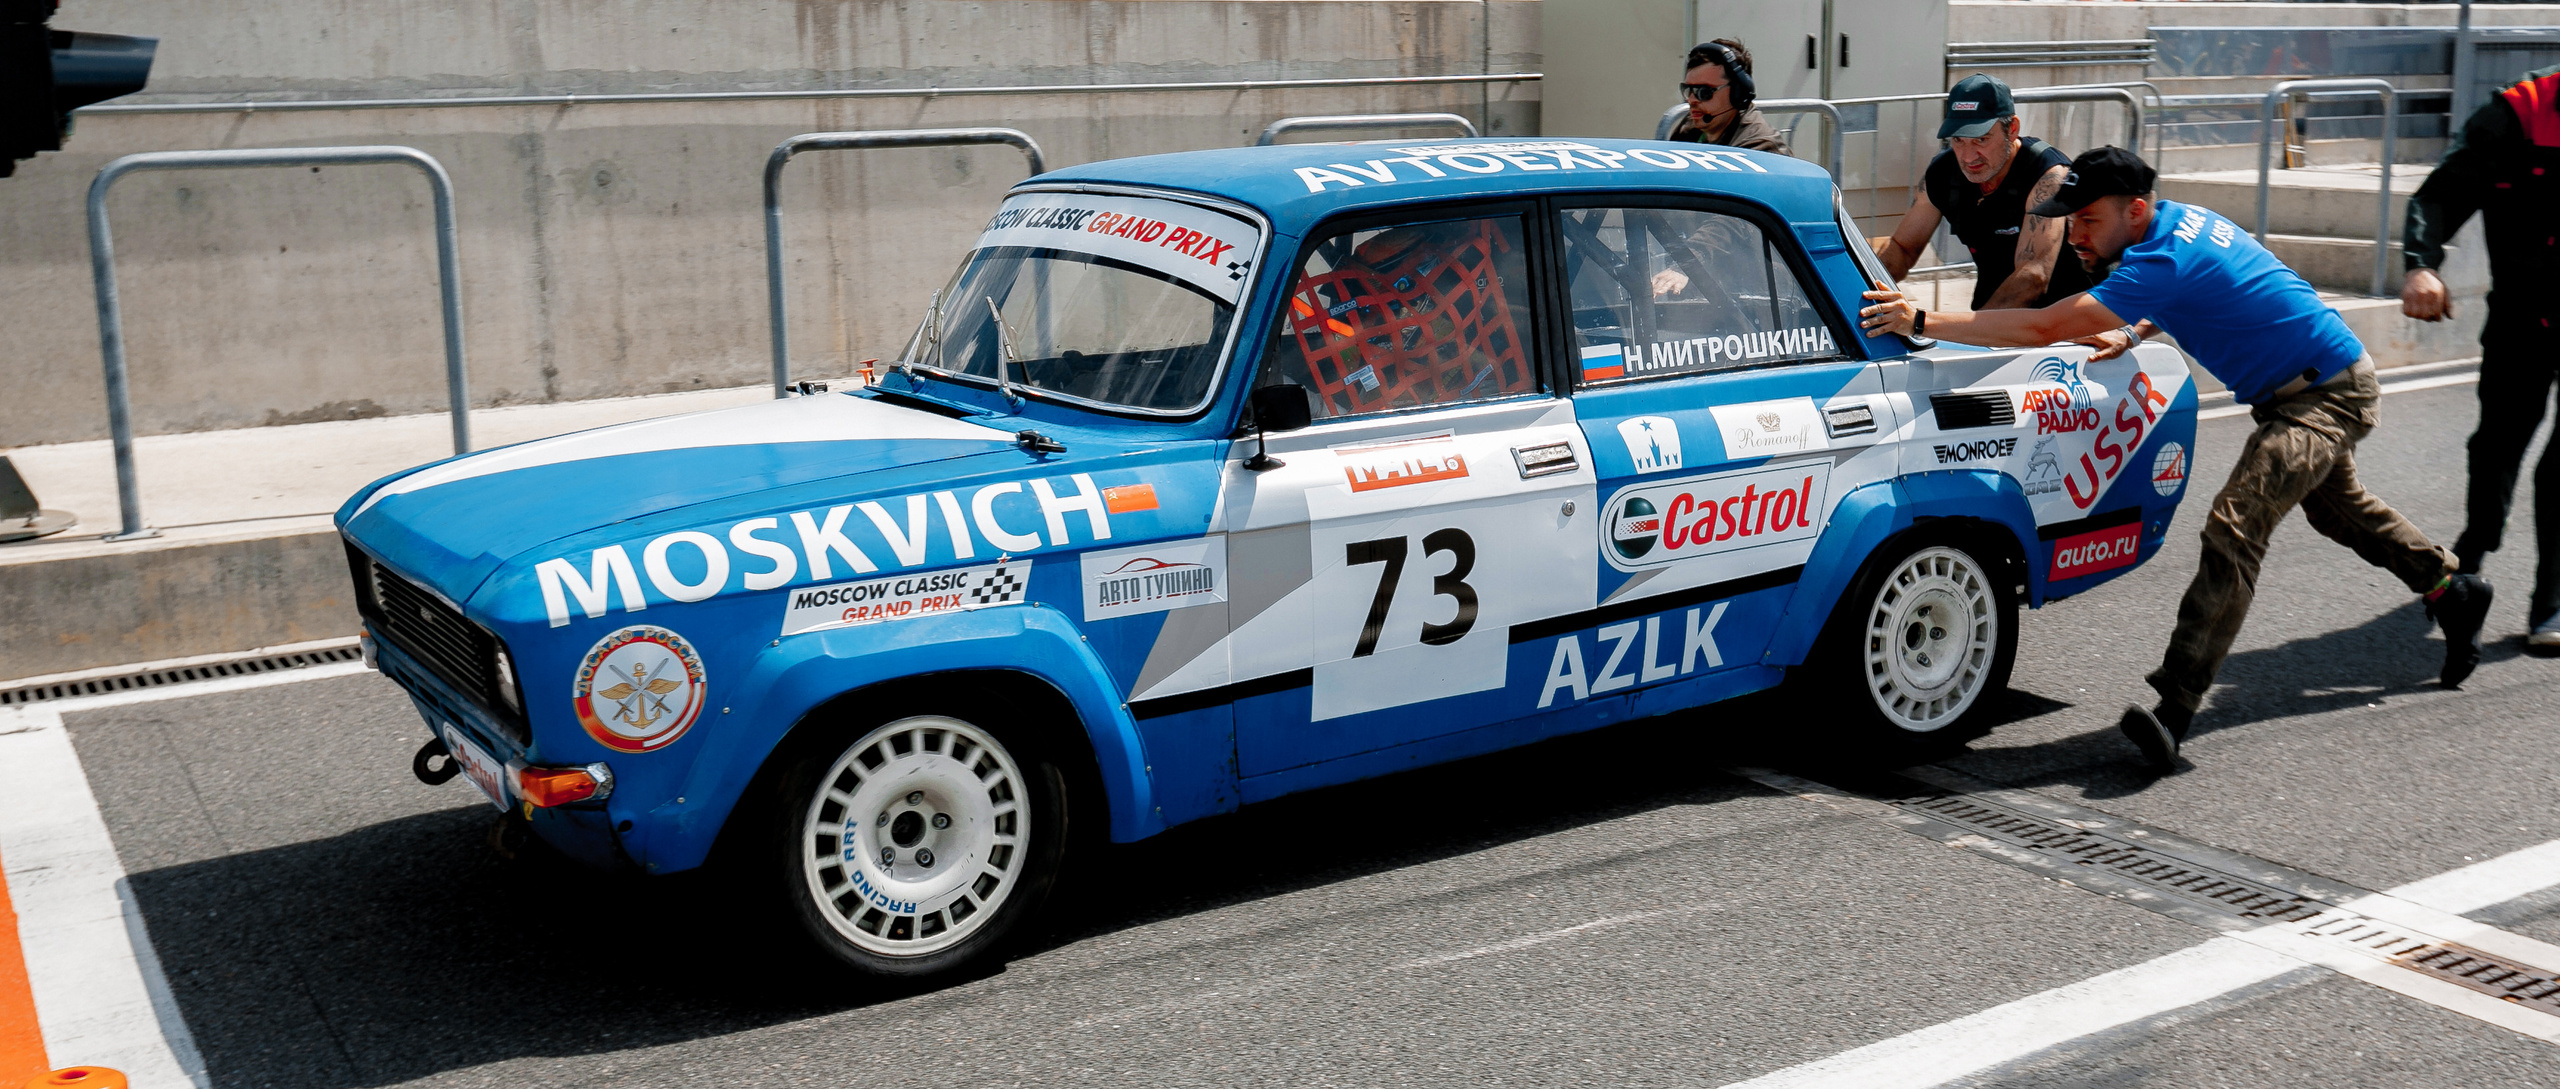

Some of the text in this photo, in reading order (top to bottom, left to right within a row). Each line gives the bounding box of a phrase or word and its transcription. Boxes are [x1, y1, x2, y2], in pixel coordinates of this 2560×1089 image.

[1293, 148, 1768, 193] AVTOEXPORT
[982, 207, 1235, 267] OSCOW CLASSIC GRAND PRIX
[1329, 300, 1357, 316] sparco
[1624, 326, 1835, 372] Н.МИТРОШКИНА
[2021, 387, 2071, 413] АВТО
[1735, 425, 1811, 450] Romanoff
[2037, 407, 2100, 436] РАДИО
[2063, 371, 2168, 510] USSR
[1944, 438, 2007, 463] MONROE
[2024, 479, 2061, 496] GAZ
[1663, 475, 1813, 550] Castrol
[534, 473, 1112, 629] MOSKVICH
[2056, 535, 2137, 569] auto.ru
[794, 572, 968, 610] MOSCOW CLASSIC
[1099, 567, 1213, 604] АВТО ТУШИНО
[1346, 527, 1479, 659] 73
[842, 593, 963, 624] GRAND PRIX
[577, 627, 703, 693] ДОСААФ РОССИИ
[1537, 601, 1730, 709] AZLK
[843, 817, 858, 862] ART
